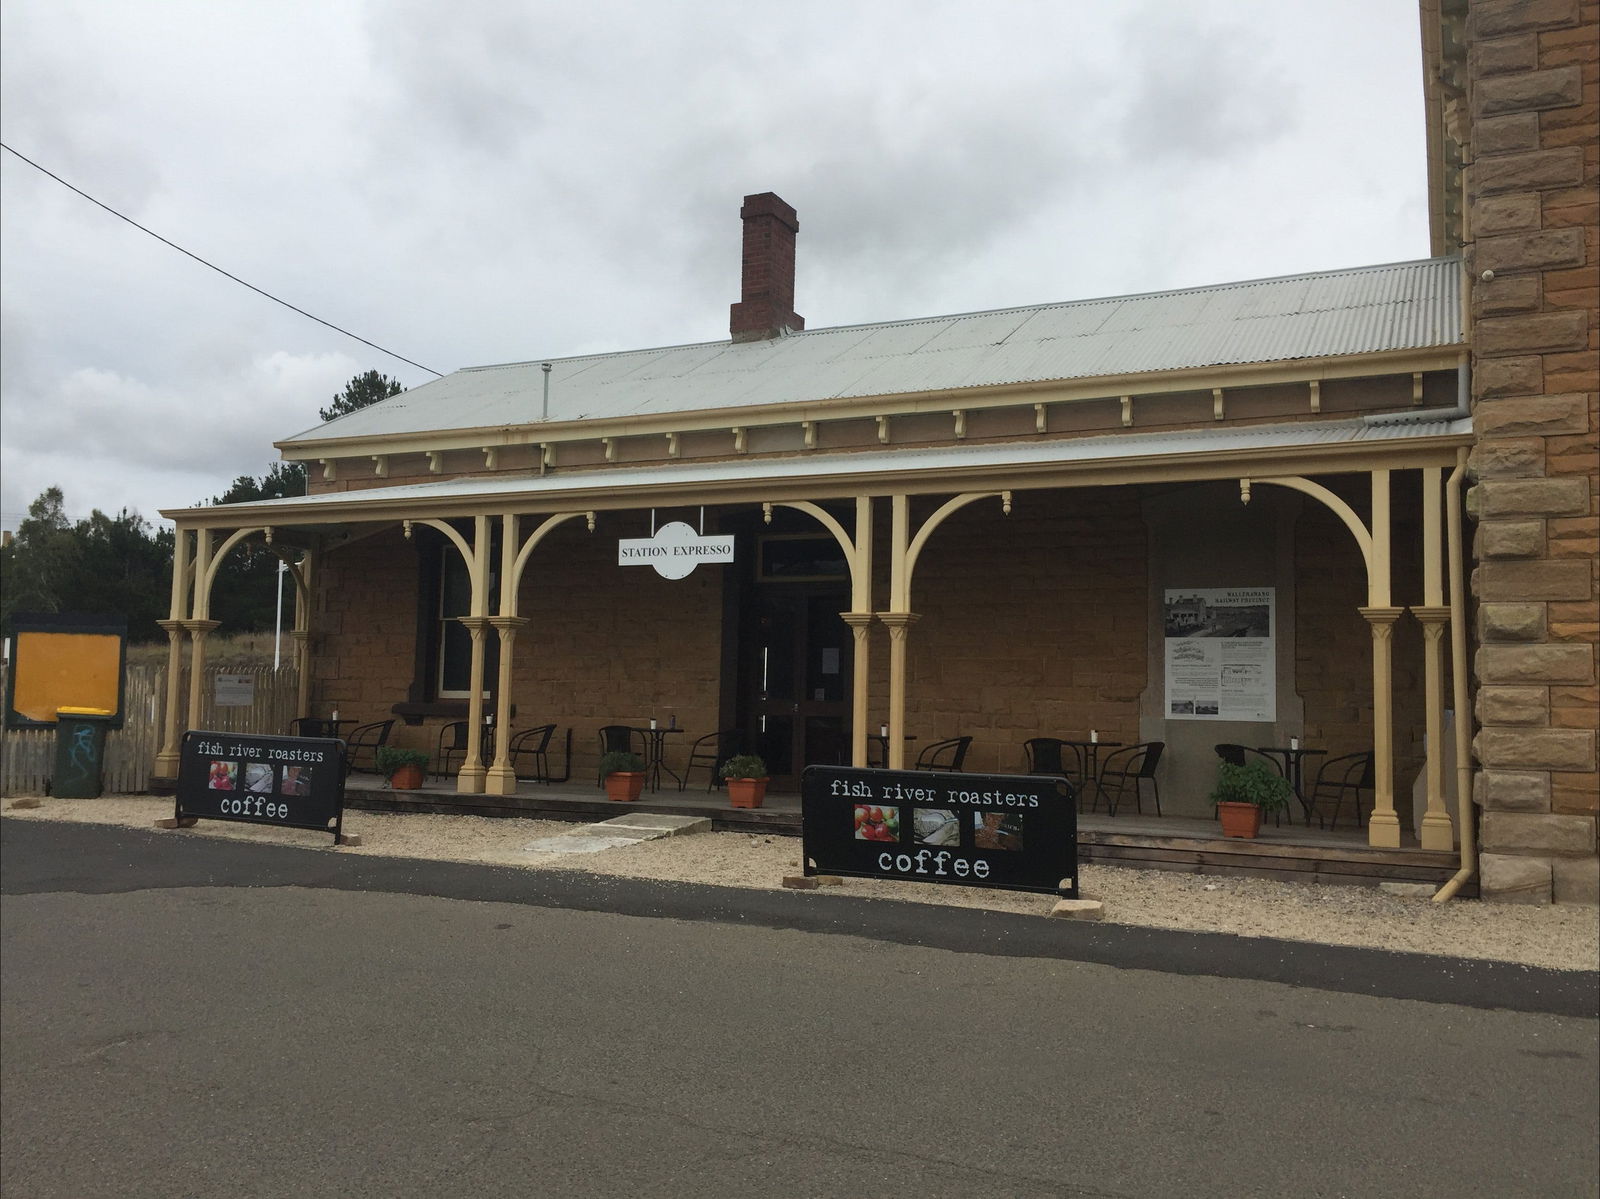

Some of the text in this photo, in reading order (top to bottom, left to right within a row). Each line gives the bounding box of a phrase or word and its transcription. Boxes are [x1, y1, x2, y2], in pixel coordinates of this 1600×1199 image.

[622, 544, 731, 558] STATION EXPRESSO
[198, 741, 324, 762] fish river roasters
[830, 779, 1039, 808] fish river roasters
[220, 795, 288, 818] coffee
[878, 849, 990, 878] coffee
